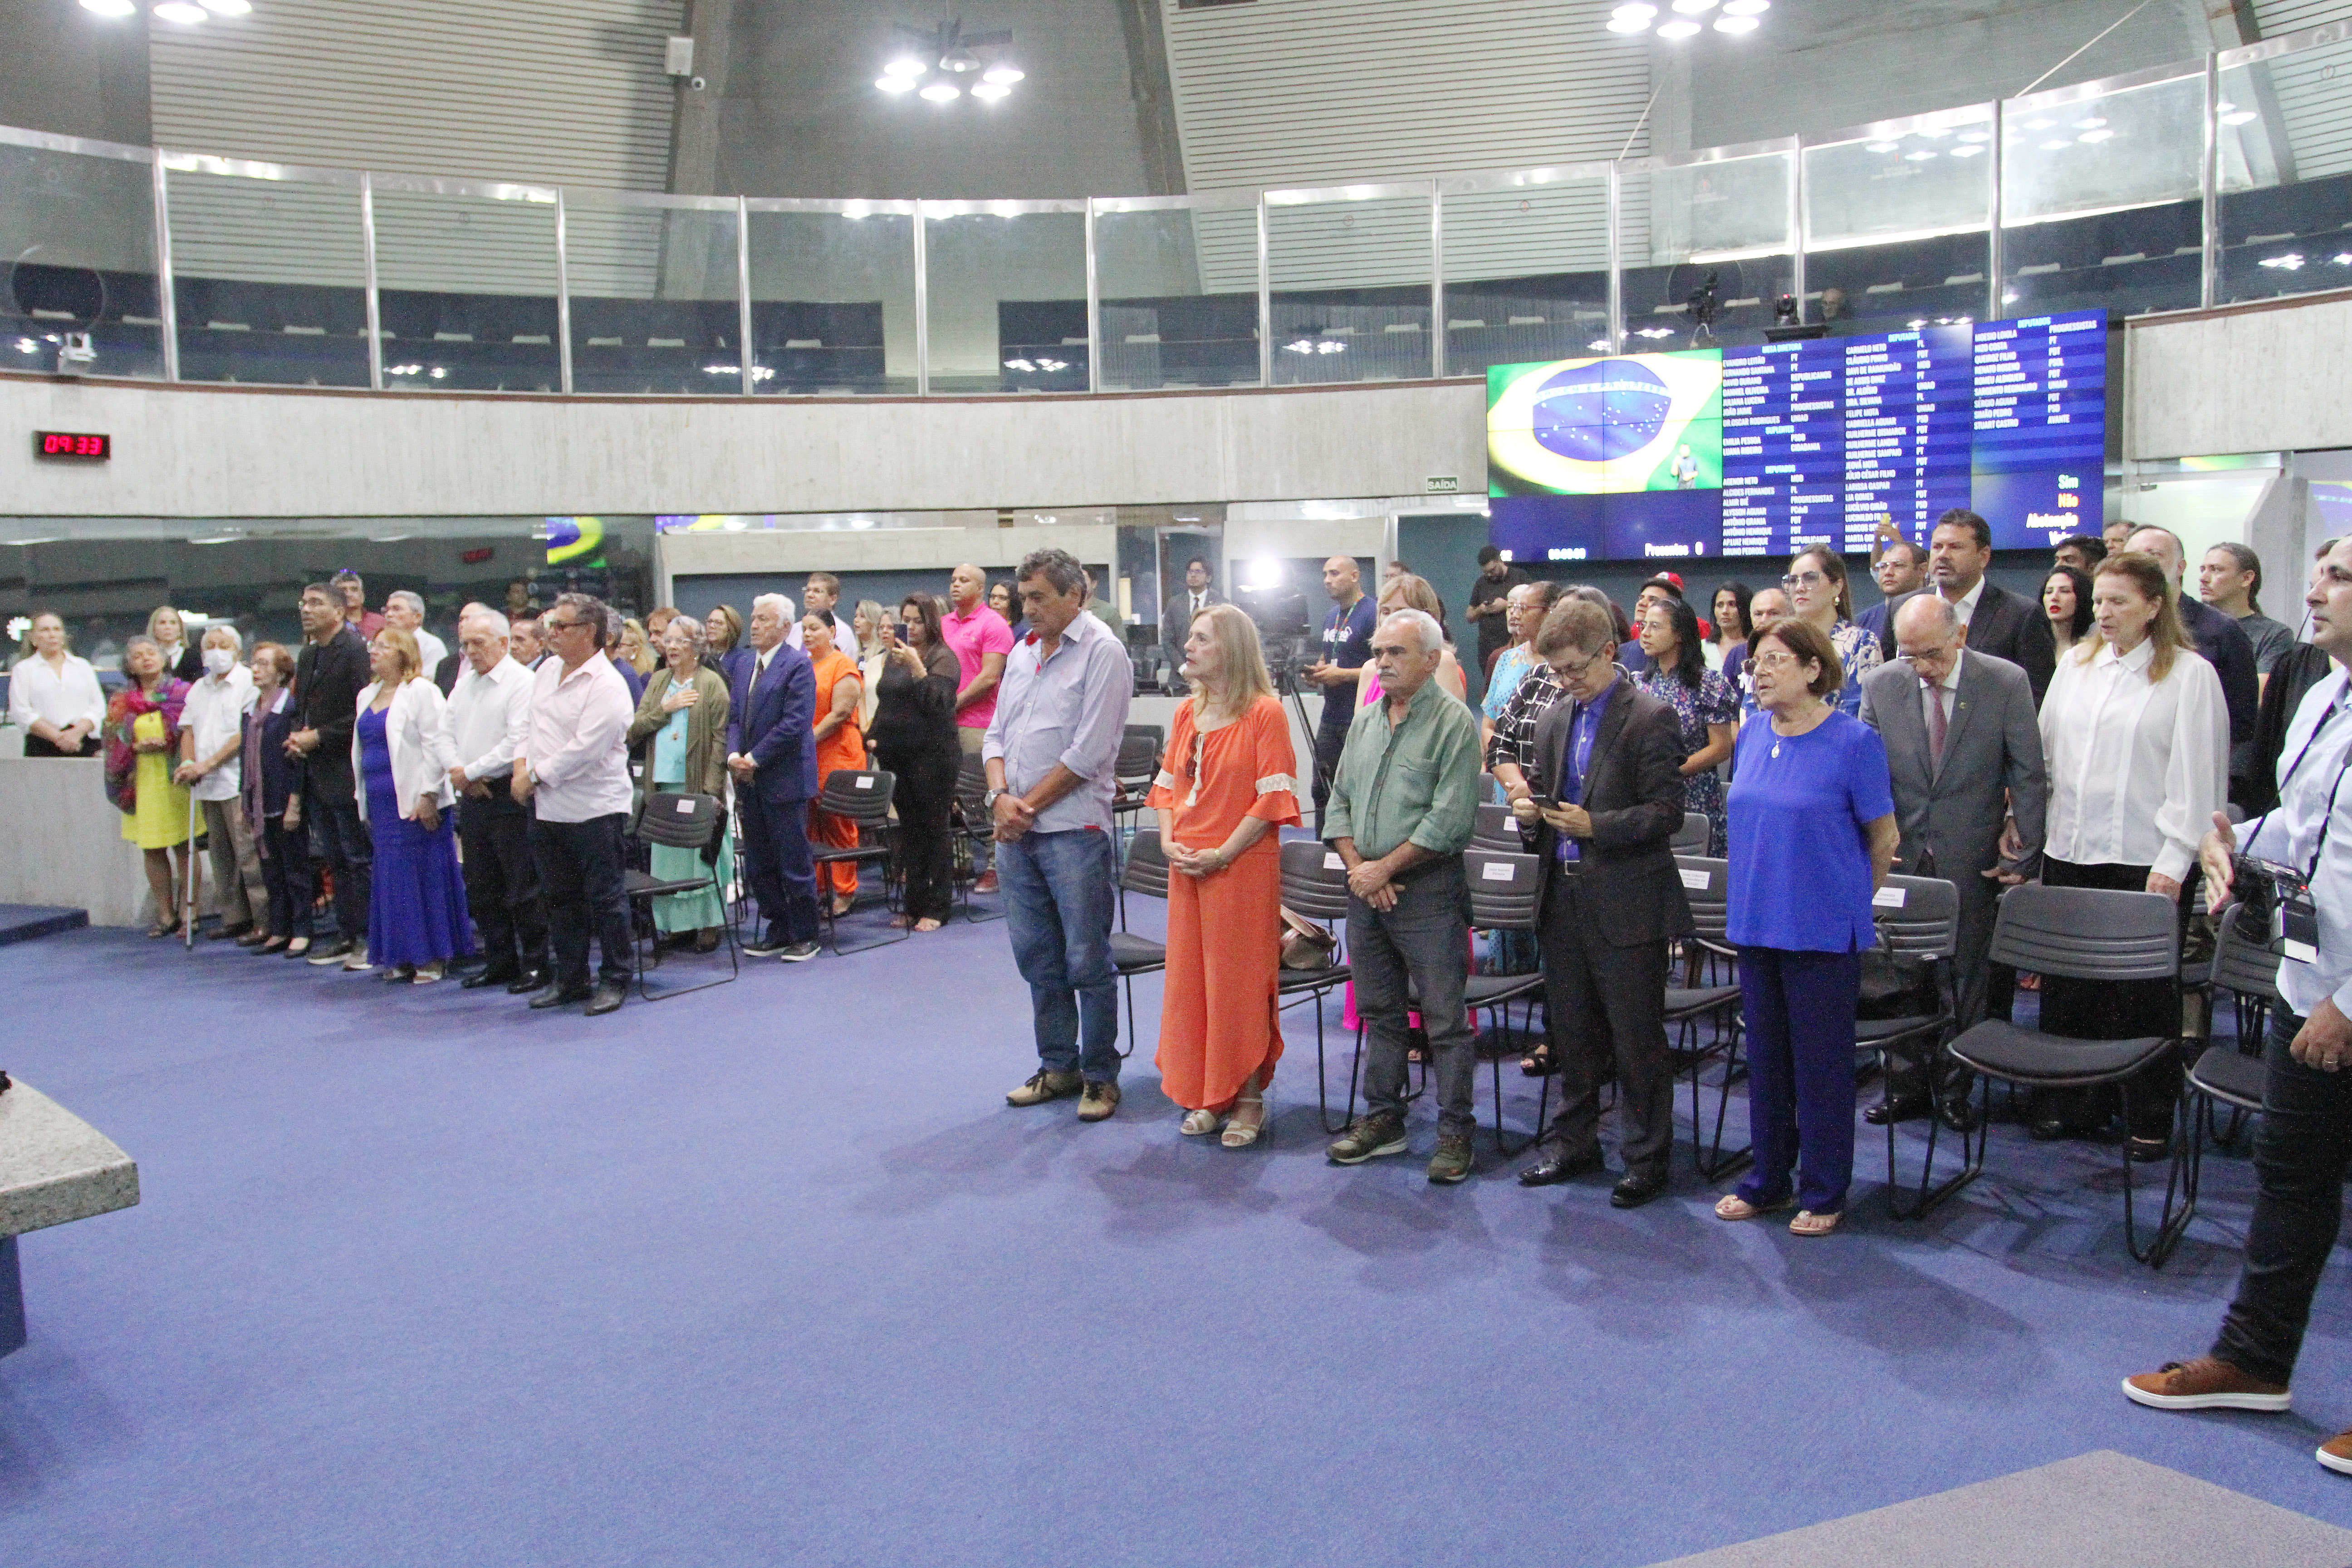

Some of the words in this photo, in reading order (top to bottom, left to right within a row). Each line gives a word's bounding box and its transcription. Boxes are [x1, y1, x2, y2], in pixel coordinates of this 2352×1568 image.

[2047, 414, 2070, 424] AVANTE
[44, 435, 103, 455] 09:33
[1916, 446, 1924, 455] PT
[1916, 457, 1927, 466] PDT
[1916, 468, 1924, 476] PT
[1428, 479, 1457, 490] SAÍDA
[1916, 480, 1923, 488] PT
[2058, 475, 2078, 489] Sim
[1916, 490, 1927, 498] PDT
[1790, 495, 1833, 504] PROGRESSISTAS
[2058, 493, 2078, 508] Não
[1790, 516, 1801, 524] PDT
[1790, 526, 1802, 534] PDT
[1790, 535, 1831, 544] REPUBLICANOS
[1915, 532, 1923, 540] PL
[1645, 543, 1689, 557] Presentes
[1695, 541, 1703, 556] 0
